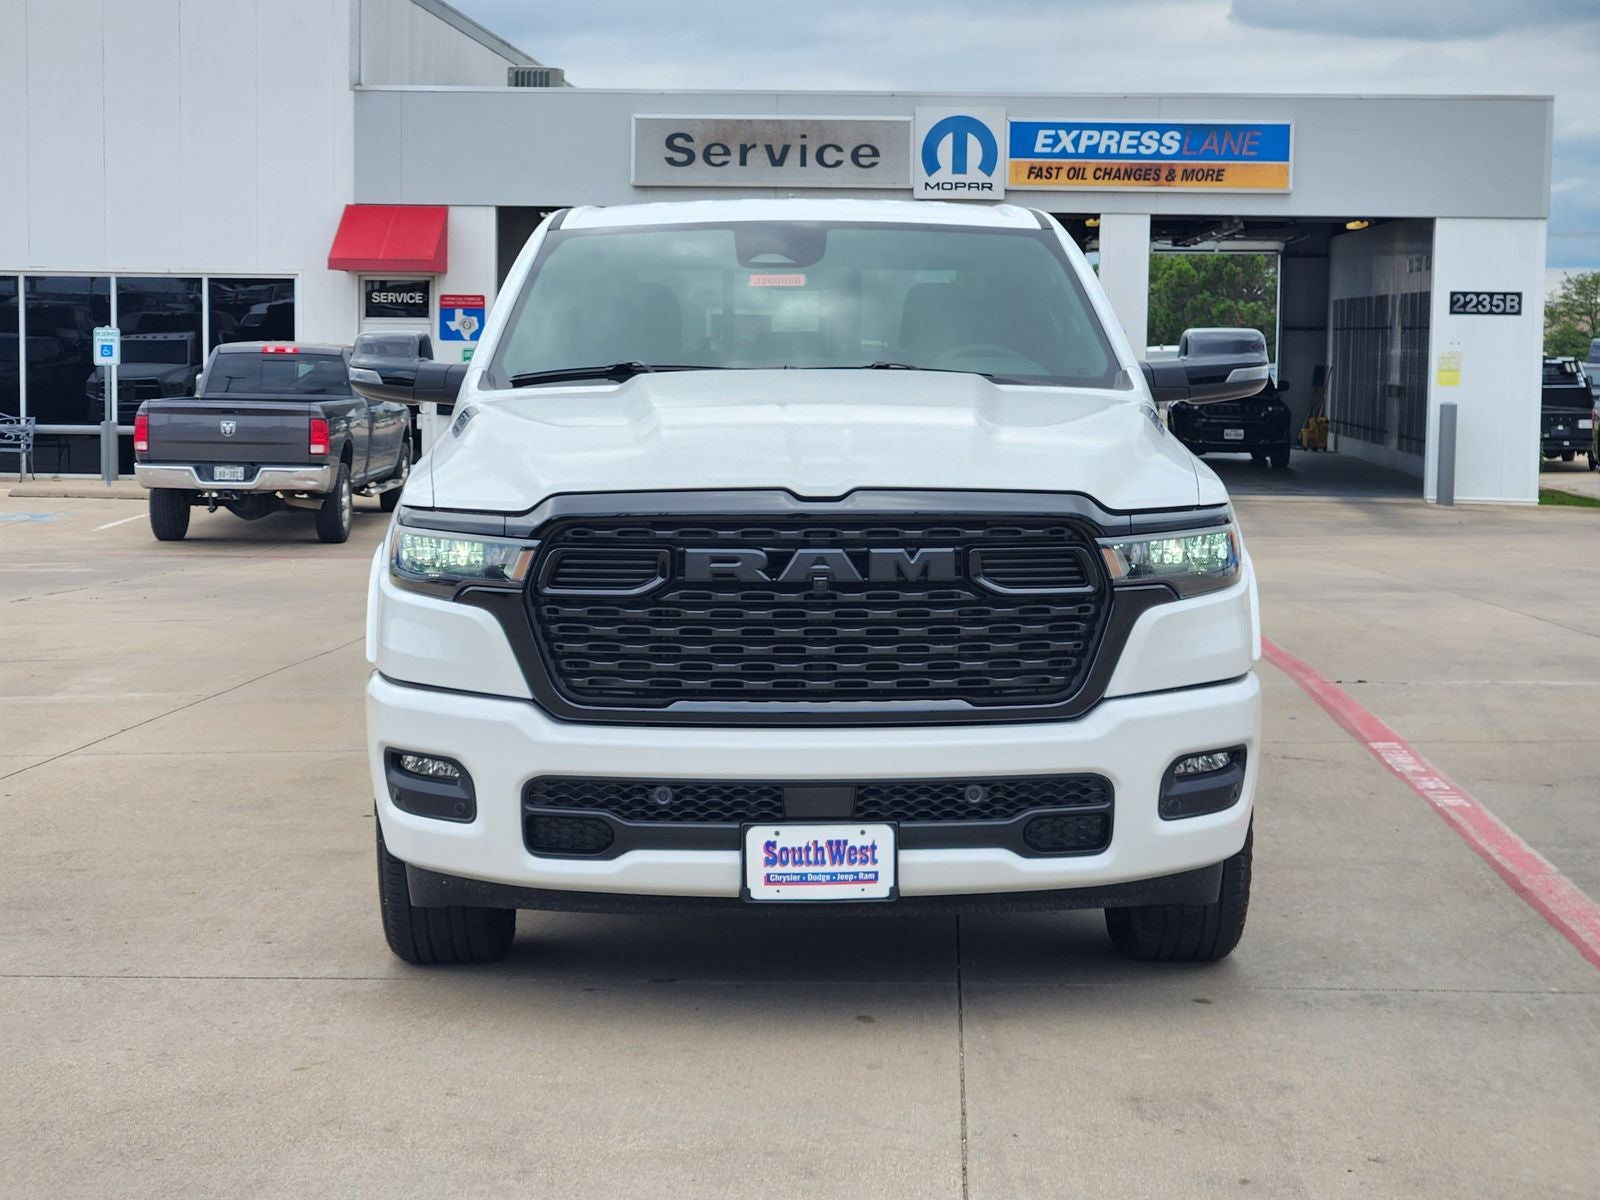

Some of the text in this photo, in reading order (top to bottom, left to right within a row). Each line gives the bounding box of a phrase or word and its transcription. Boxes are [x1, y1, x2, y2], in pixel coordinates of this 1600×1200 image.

[664, 132, 881, 169] Service
[1027, 166, 1226, 182] FAST OIL CHANGES & MORE
[924, 181, 994, 191] MOPAR
[371, 291, 424, 304] SERVICE
[1452, 293, 1520, 313] 2235B
[684, 547, 956, 582] RAM
[769, 873, 801, 883] Chrysler
[807, 873, 831, 882] Dodge
[836, 873, 854, 882] Jeep
